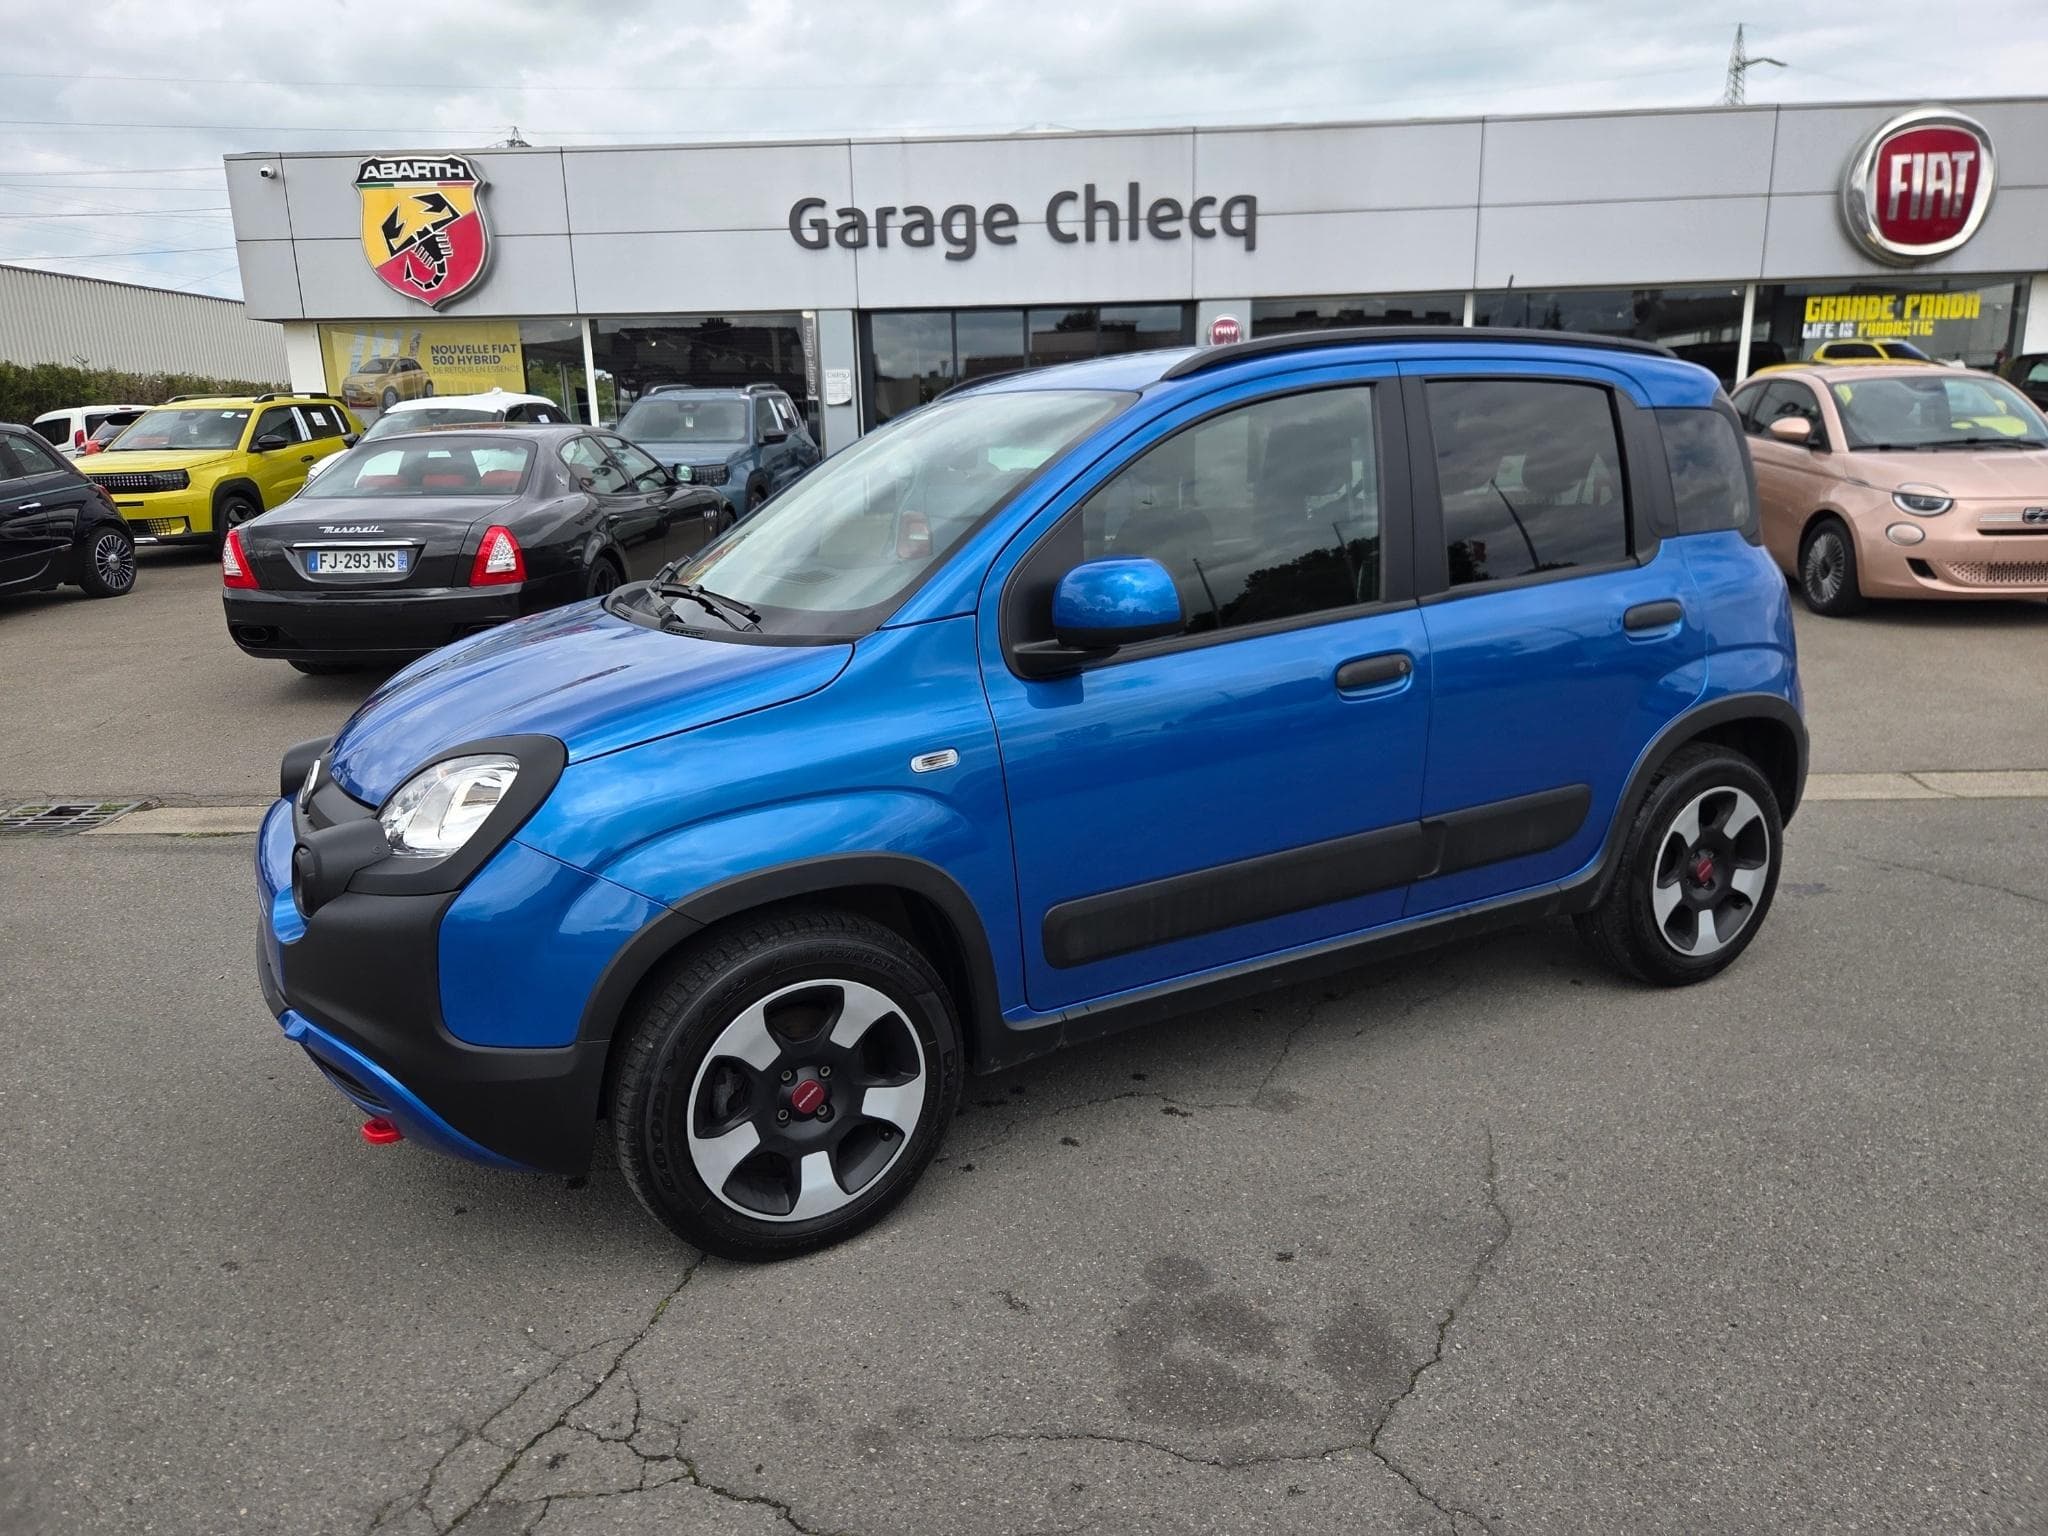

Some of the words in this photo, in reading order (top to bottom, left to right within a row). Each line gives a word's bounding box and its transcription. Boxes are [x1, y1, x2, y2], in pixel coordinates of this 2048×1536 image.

[363, 162, 465, 179] ABARTH
[1887, 151, 1975, 220] FIAT
[789, 197, 1019, 261] Garage
[1046, 182, 1257, 252] Chlecq
[1804, 294, 1896, 322] GRANDE
[1903, 292, 1980, 320] PANDA
[1802, 322, 1834, 339] LIFE
[1838, 321, 1854, 338] IS
[1857, 320, 1934, 338] PANDASTIC
[431, 344, 489, 355] NOUVELLE
[491, 344, 517, 354] FIAT
[432, 355, 455, 365] 500
[457, 355, 501, 365] HYBRID
[433, 366, 443, 374] DE
[444, 366, 475, 374] RETOUR
[487, 365, 520, 374] ESSENCE
[319, 552, 396, 570] FJ-293-NS
